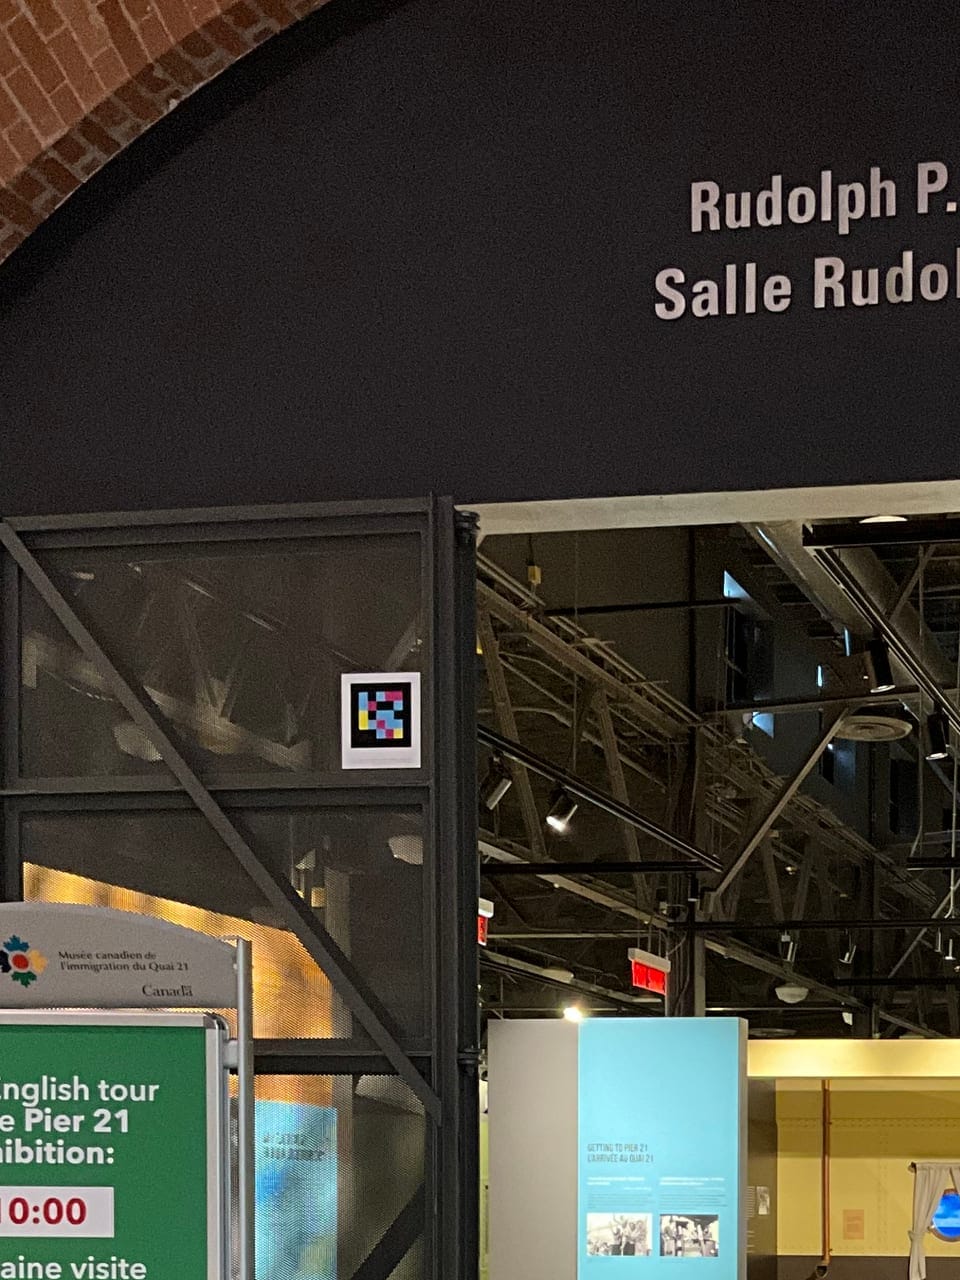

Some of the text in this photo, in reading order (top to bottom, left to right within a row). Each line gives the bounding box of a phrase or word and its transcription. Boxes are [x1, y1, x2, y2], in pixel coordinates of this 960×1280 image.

[690, 166, 897, 235] Rudolph
[917, 161, 958, 213] P.
[653, 262, 792, 320] Salle
[58, 950, 157, 961] Musée canadien de
[132, 961, 146, 971] du
[149, 962, 174, 972] Quai
[177, 963, 189, 971] 21
[142, 984, 193, 997] Canada
[0, 1075, 160, 1108] nglish tour
[0, 1107, 129, 1133] e Pier 21
[0, 1138, 114, 1164] ibition:
[0, 1197, 86, 1225] 0:00
[0, 1255, 147, 1280] aine visite
